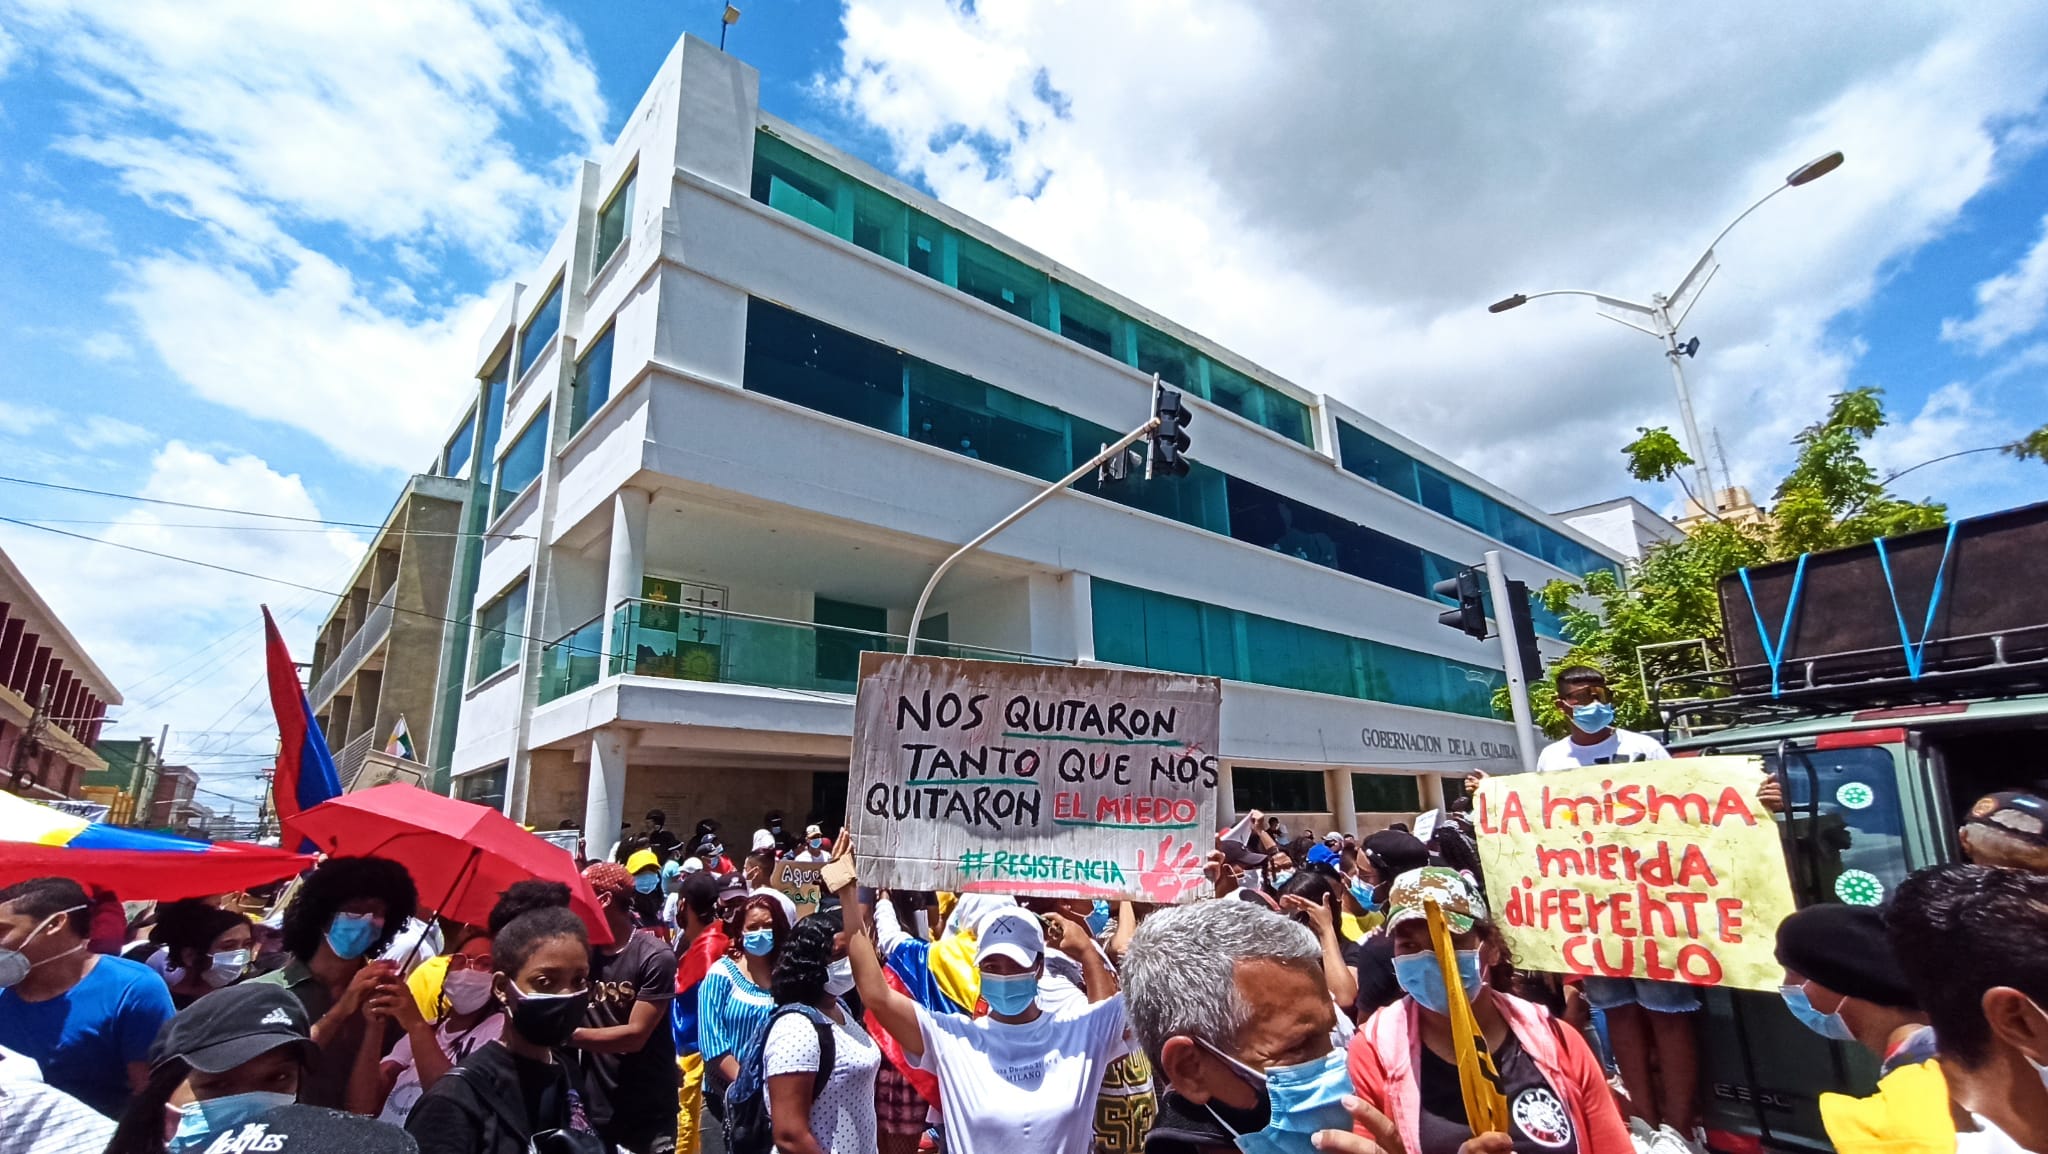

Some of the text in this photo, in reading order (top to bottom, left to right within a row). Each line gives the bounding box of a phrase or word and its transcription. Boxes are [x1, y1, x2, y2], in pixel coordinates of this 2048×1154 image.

[897, 689, 1176, 739] NOS QUITARON
[1362, 728, 1442, 753] GOBERNACION
[1448, 738, 1462, 754] DE
[1463, 740, 1476, 756] LA
[902, 743, 1219, 788] TANTO QUE NOS
[866, 783, 1041, 830] QUITARON
[1054, 792, 1088, 819] EL
[1480, 791, 1531, 834] LA
[958, 848, 1126, 885] #RESISTENCIA
[1562, 935, 1723, 986] CULO
